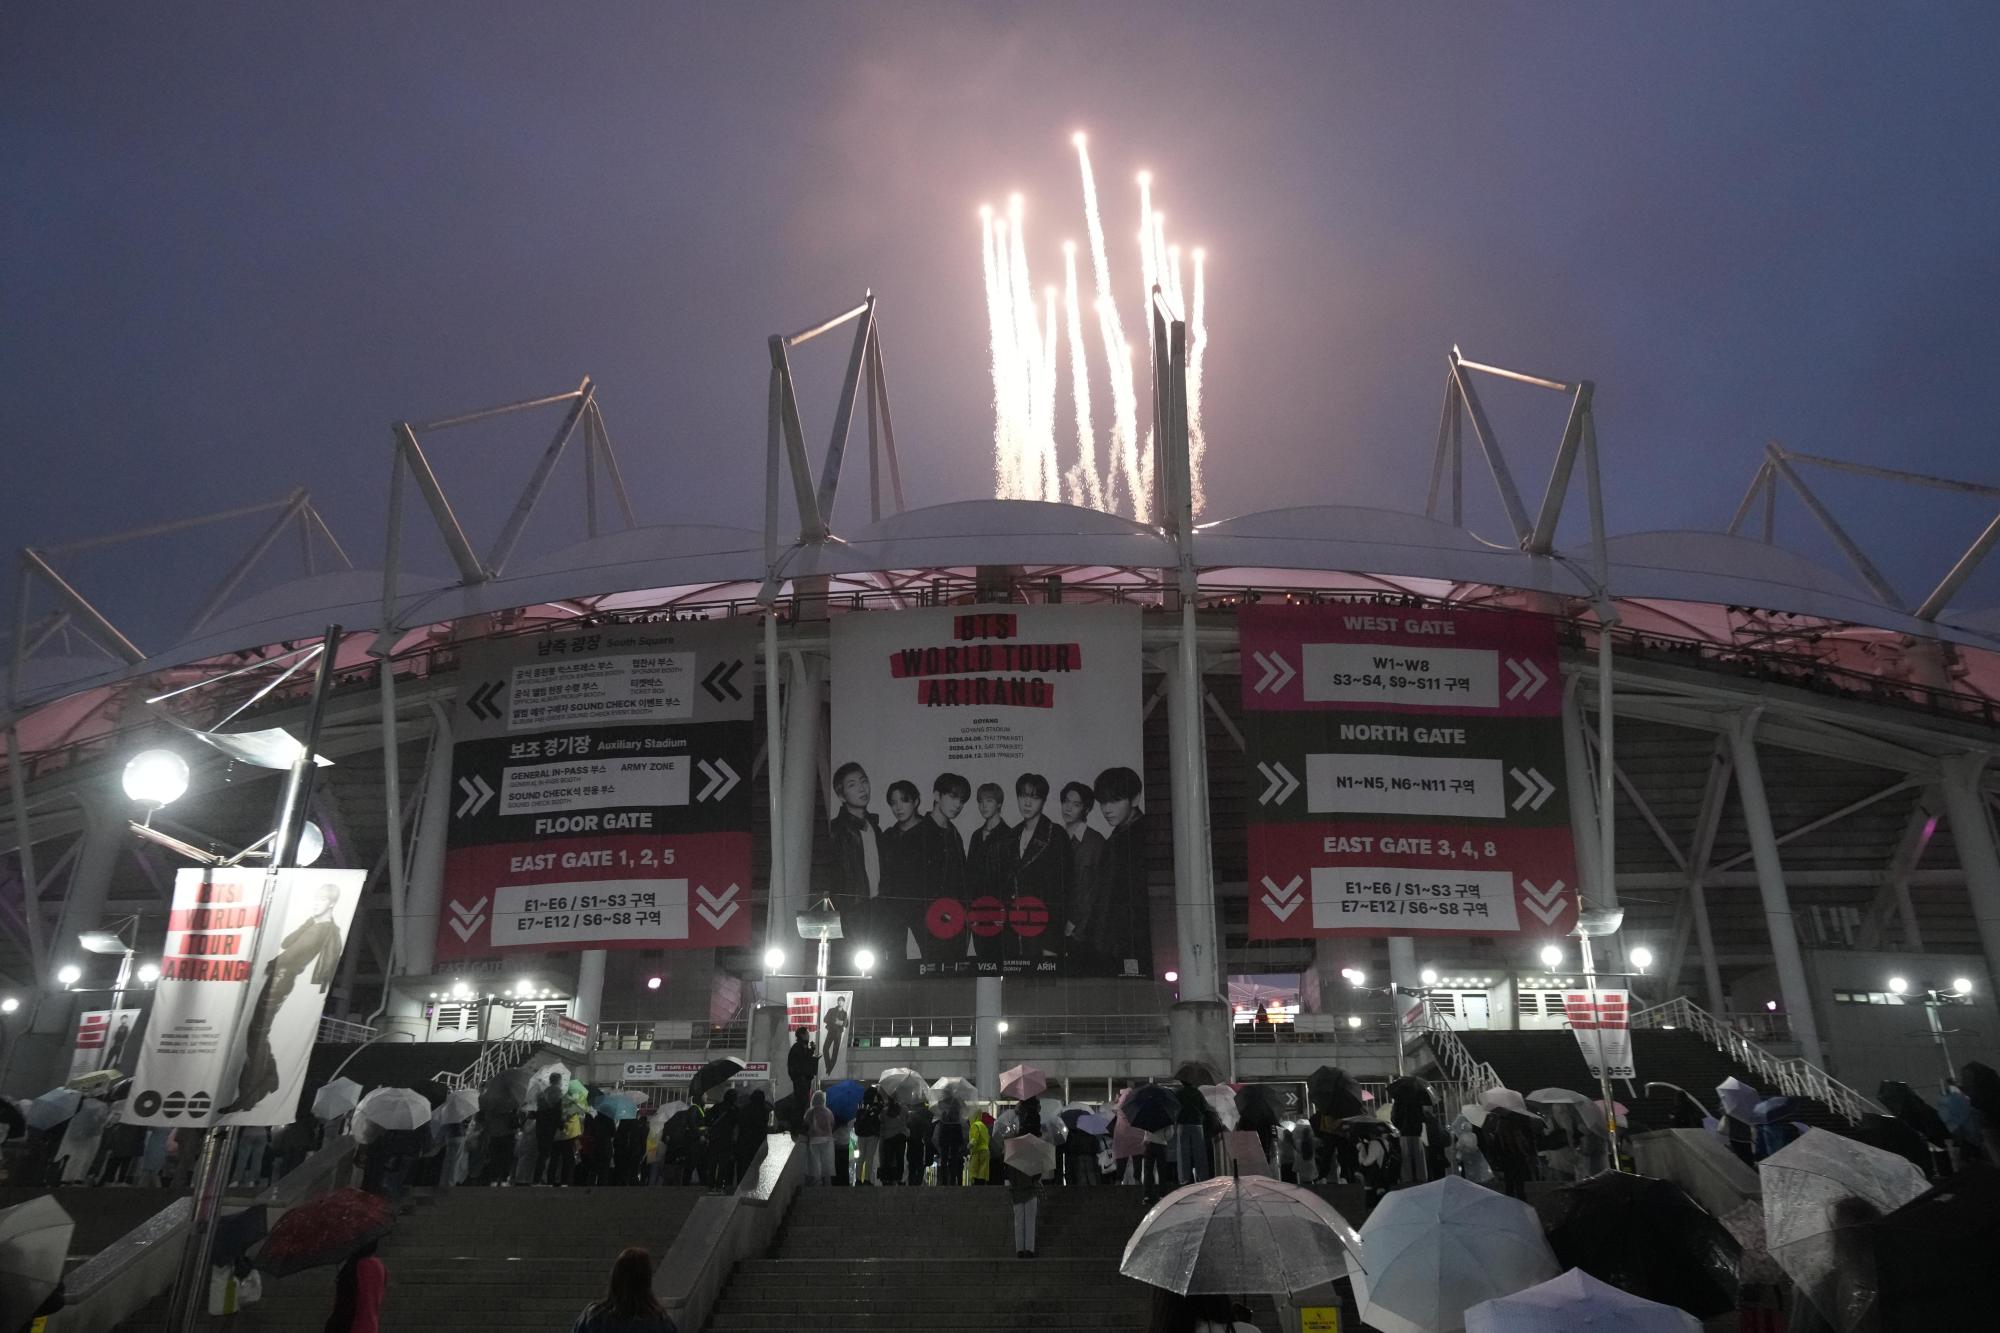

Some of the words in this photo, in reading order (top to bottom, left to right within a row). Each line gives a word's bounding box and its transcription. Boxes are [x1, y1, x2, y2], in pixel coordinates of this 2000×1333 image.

[960, 614, 1010, 640] BTS
[1342, 615, 1399, 632] WEST
[1404, 618, 1456, 636] GATE
[538, 638, 567, 656] 남측
[572, 634, 601, 653] 광장
[607, 638, 636, 648] South
[639, 637, 674, 648] Square
[598, 662, 615, 670] 부스
[657, 658, 673, 666] 부스
[901, 644, 992, 676] WORLD
[1003, 644, 1070, 672] TOUR
[1372, 657, 1430, 672] W1~W8
[583, 682, 598, 690] 부스
[928, 677, 1045, 707] ARIRANG
[1333, 674, 1386, 690] S3~S4,
[1389, 676, 1441, 690] S9~S11
[1444, 677, 1470, 692] 구역
[571, 702, 603, 711] SOUND
[606, 700, 637, 709] CHECK
[639, 698, 663, 707] 이벤트
[665, 698, 680, 706] 부스
[1339, 724, 1409, 742] NORTH
[1413, 727, 1467, 744] GATE
[510, 741, 540, 759] 보조
[544, 735, 591, 757] 경기장
[597, 739, 642, 751] Auxiliary
[645, 738, 687, 749] Stadium
[511, 769, 549, 780] GENERAL
[552, 766, 589, 776] IN-PASS
[591, 765, 607, 774] 부스
[621, 763, 647, 771] ARMY
[650, 762, 674, 771] ZONE
[509, 791, 540, 801] SOUND
[600, 785, 616, 794] 부스
[1336, 776, 1388, 792] N1~N5,
[1391, 778, 1446, 792] N6~N11
[1449, 780, 1475, 795] 구역
[535, 815, 598, 834] FLOOR
[603, 812, 653, 830] GATE
[1323, 836, 1374, 853] EAST
[1380, 838, 1433, 855] GATE
[1438, 839, 1457, 858] 3,
[1461, 841, 1479, 859] 4,
[1484, 842, 1498, 857] 8
[510, 853, 557, 873] EAST
[562, 850, 613, 869] GATE
[619, 850, 635, 868] 1,
[641, 850, 658, 868] 2,
[664, 849, 675, 865] 5
[199, 883, 236, 903] BTS
[1345, 881, 1392, 895] E1~E6
[1405, 883, 1452, 897] S1~S3
[1455, 885, 1481, 899] 구역
[524, 896, 567, 912] E1~E6
[580, 894, 627, 909] S1~S3
[630, 893, 656, 908] 구역
[1341, 900, 1396, 914] E7~E12
[1409, 901, 1459, 916] S6~S8
[1463, 902, 1489, 917] 구역
[187, 908, 246, 930] WORLD
[518, 915, 570, 931] E7~E12
[583, 913, 631, 927] S6~S8
[635, 911, 661, 926] 구역
[188, 934, 236, 955] TOUR
[164, 960, 249, 981] ARIRANG
[977, 963, 998, 971] VISA
